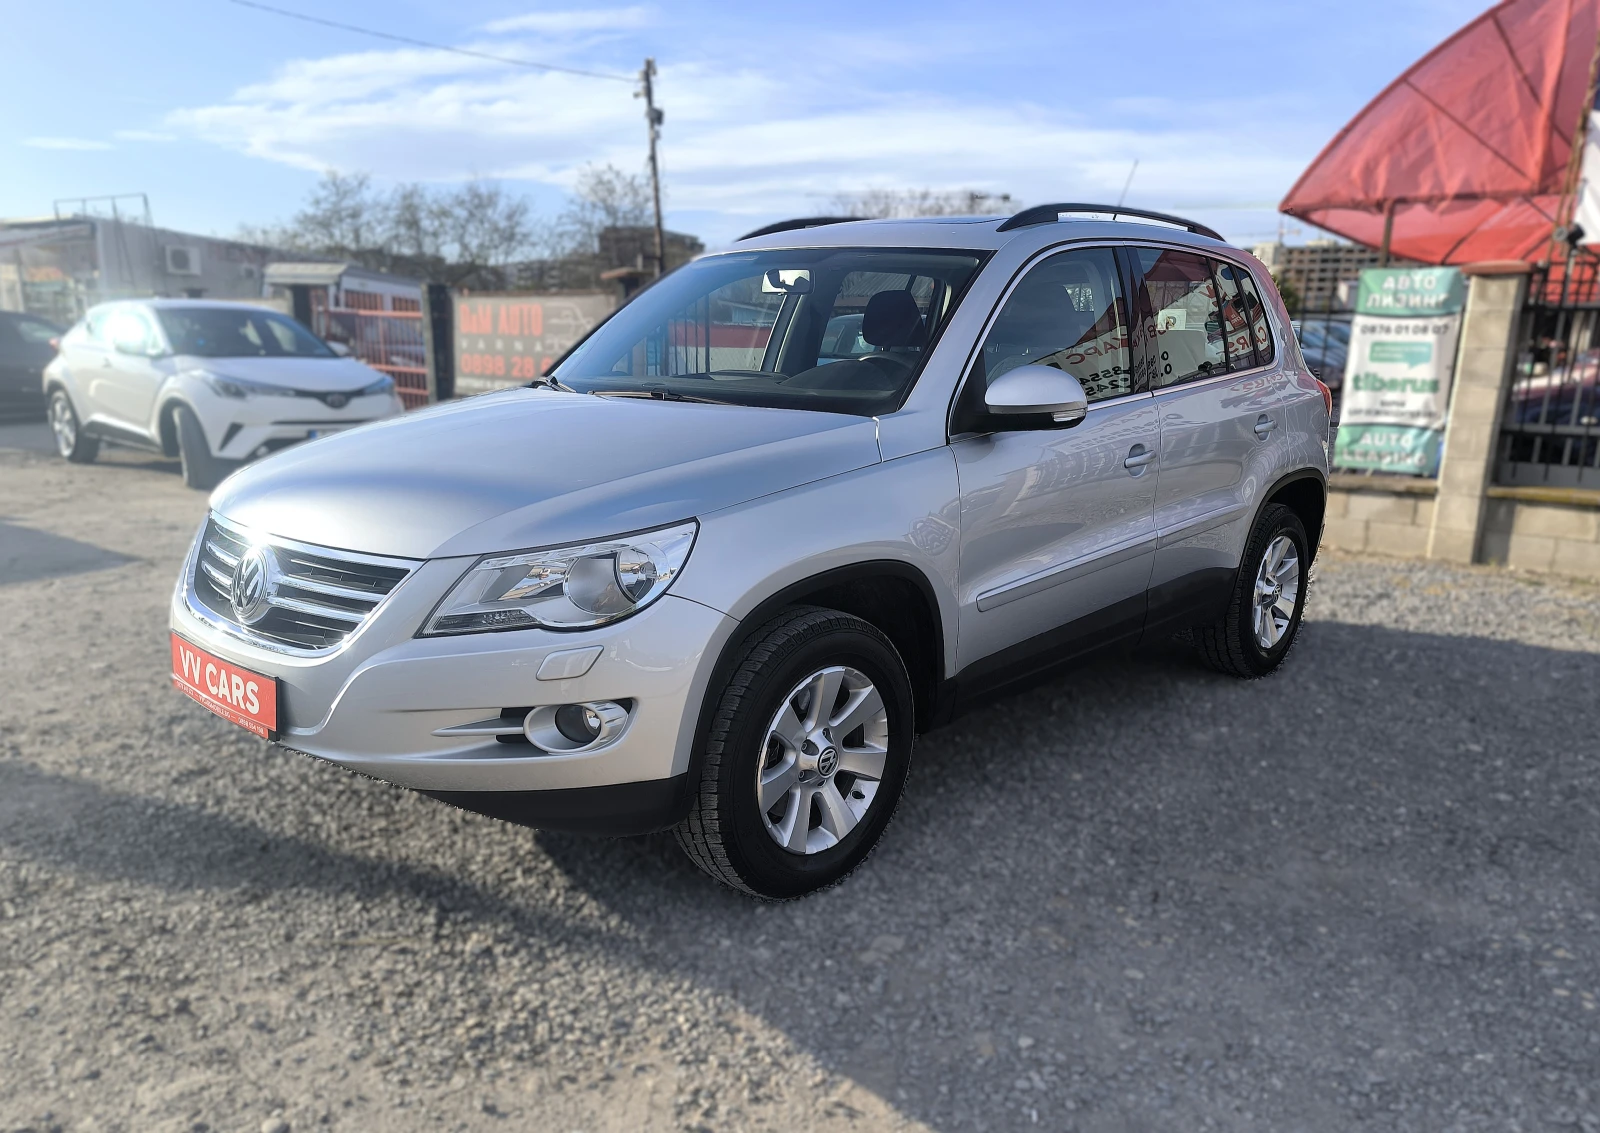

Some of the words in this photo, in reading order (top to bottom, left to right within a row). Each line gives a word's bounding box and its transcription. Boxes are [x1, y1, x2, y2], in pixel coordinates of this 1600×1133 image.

[1382, 275, 1437, 291] АВТО
[498, 304, 543, 336] AUTO
[460, 353, 505, 376] 0898
[1361, 432, 1414, 448] AUTO
[179, 644, 202, 685] VV
[205, 662, 260, 715] CARS
